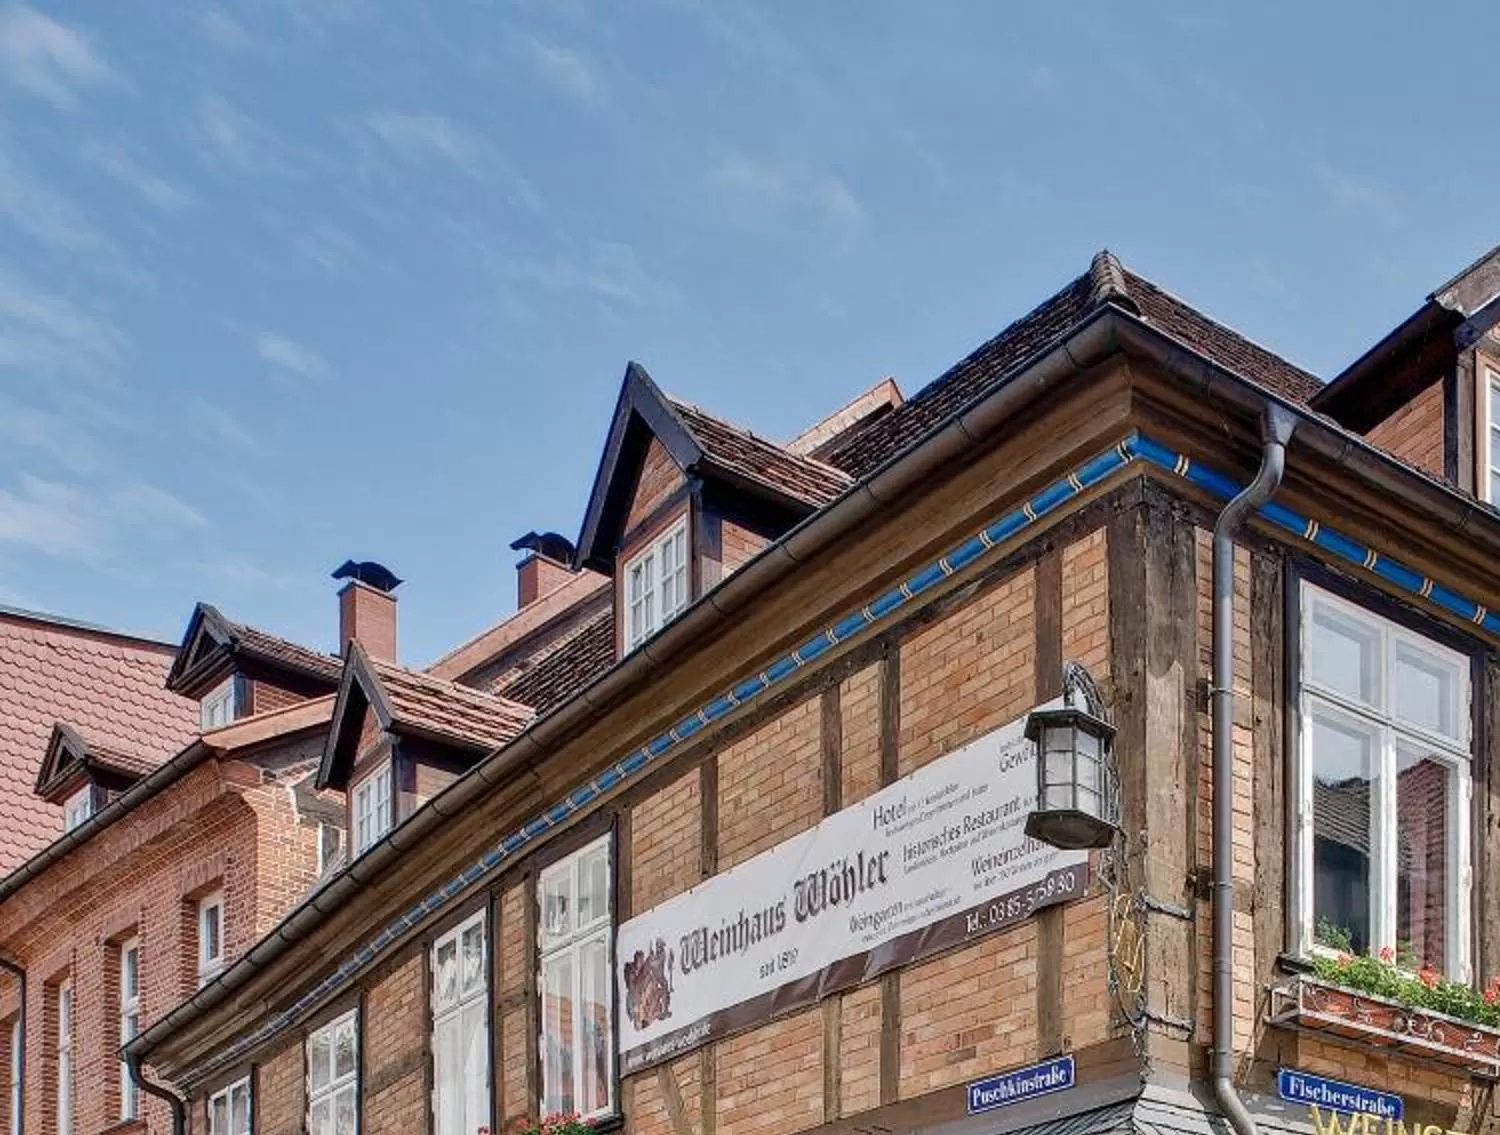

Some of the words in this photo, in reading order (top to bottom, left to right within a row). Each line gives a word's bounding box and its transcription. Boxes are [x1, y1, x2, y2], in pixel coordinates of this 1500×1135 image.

[873, 793, 906, 830] Hotel
[963, 795, 1020, 835] Restaurant
[680, 895, 786, 977] Weinhaus
[793, 850, 889, 923] Wöhler
[973, 1065, 1066, 1107] Puschkinstraße
[1289, 1074, 1396, 1117] Fischerstraße
